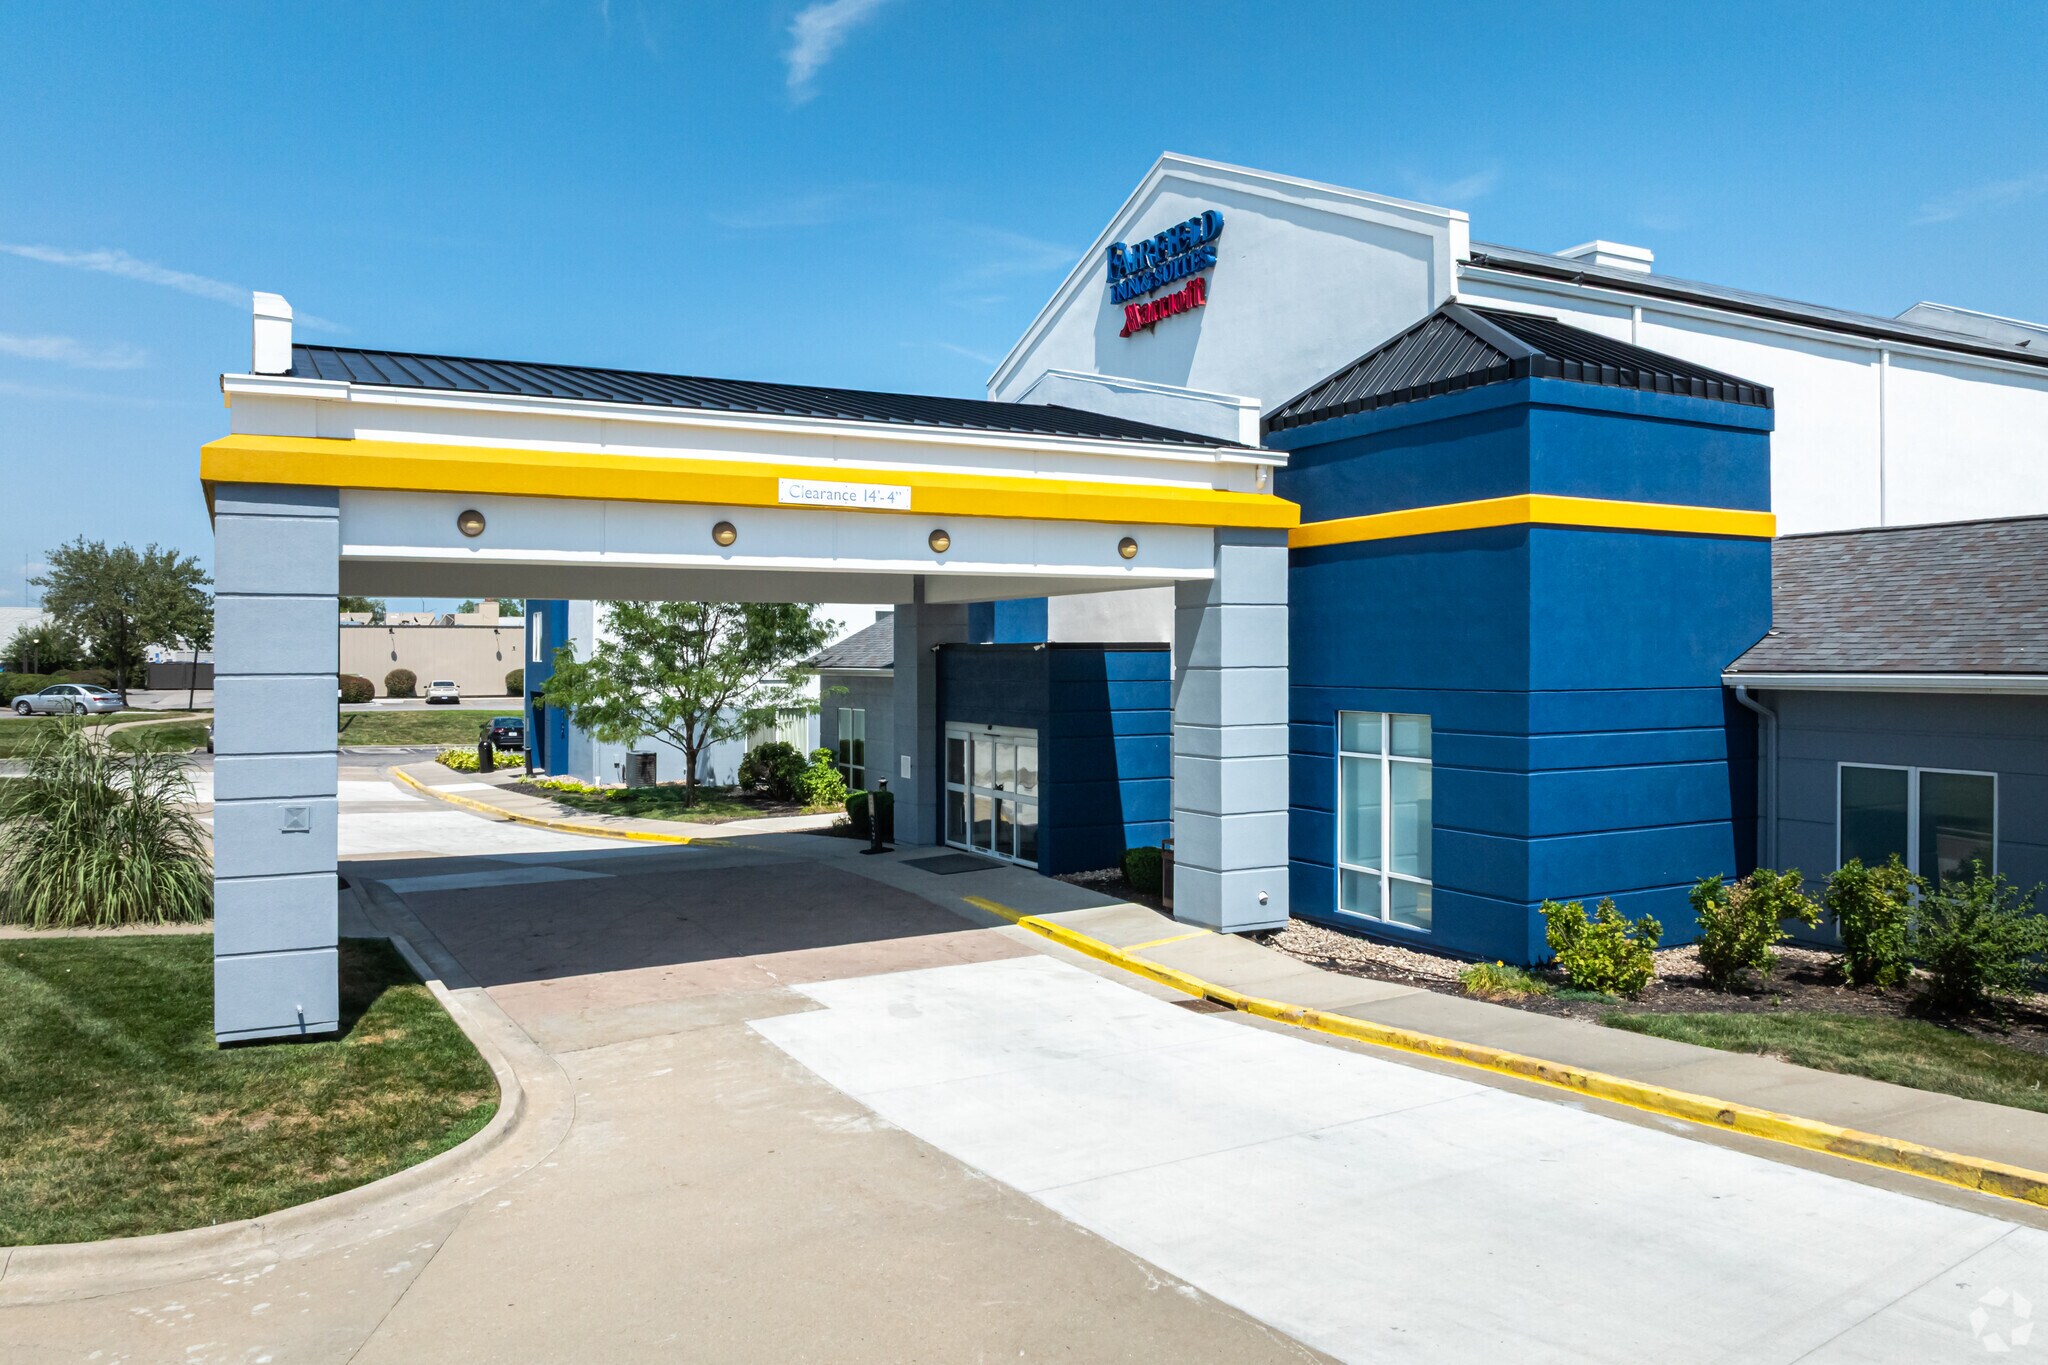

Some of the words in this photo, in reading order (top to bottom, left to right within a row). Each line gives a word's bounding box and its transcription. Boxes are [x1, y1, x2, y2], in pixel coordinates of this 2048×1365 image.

[1105, 210, 1224, 283] FAIRFIELD
[1119, 277, 1206, 338] Marriott
[789, 484, 857, 502] Clearance
